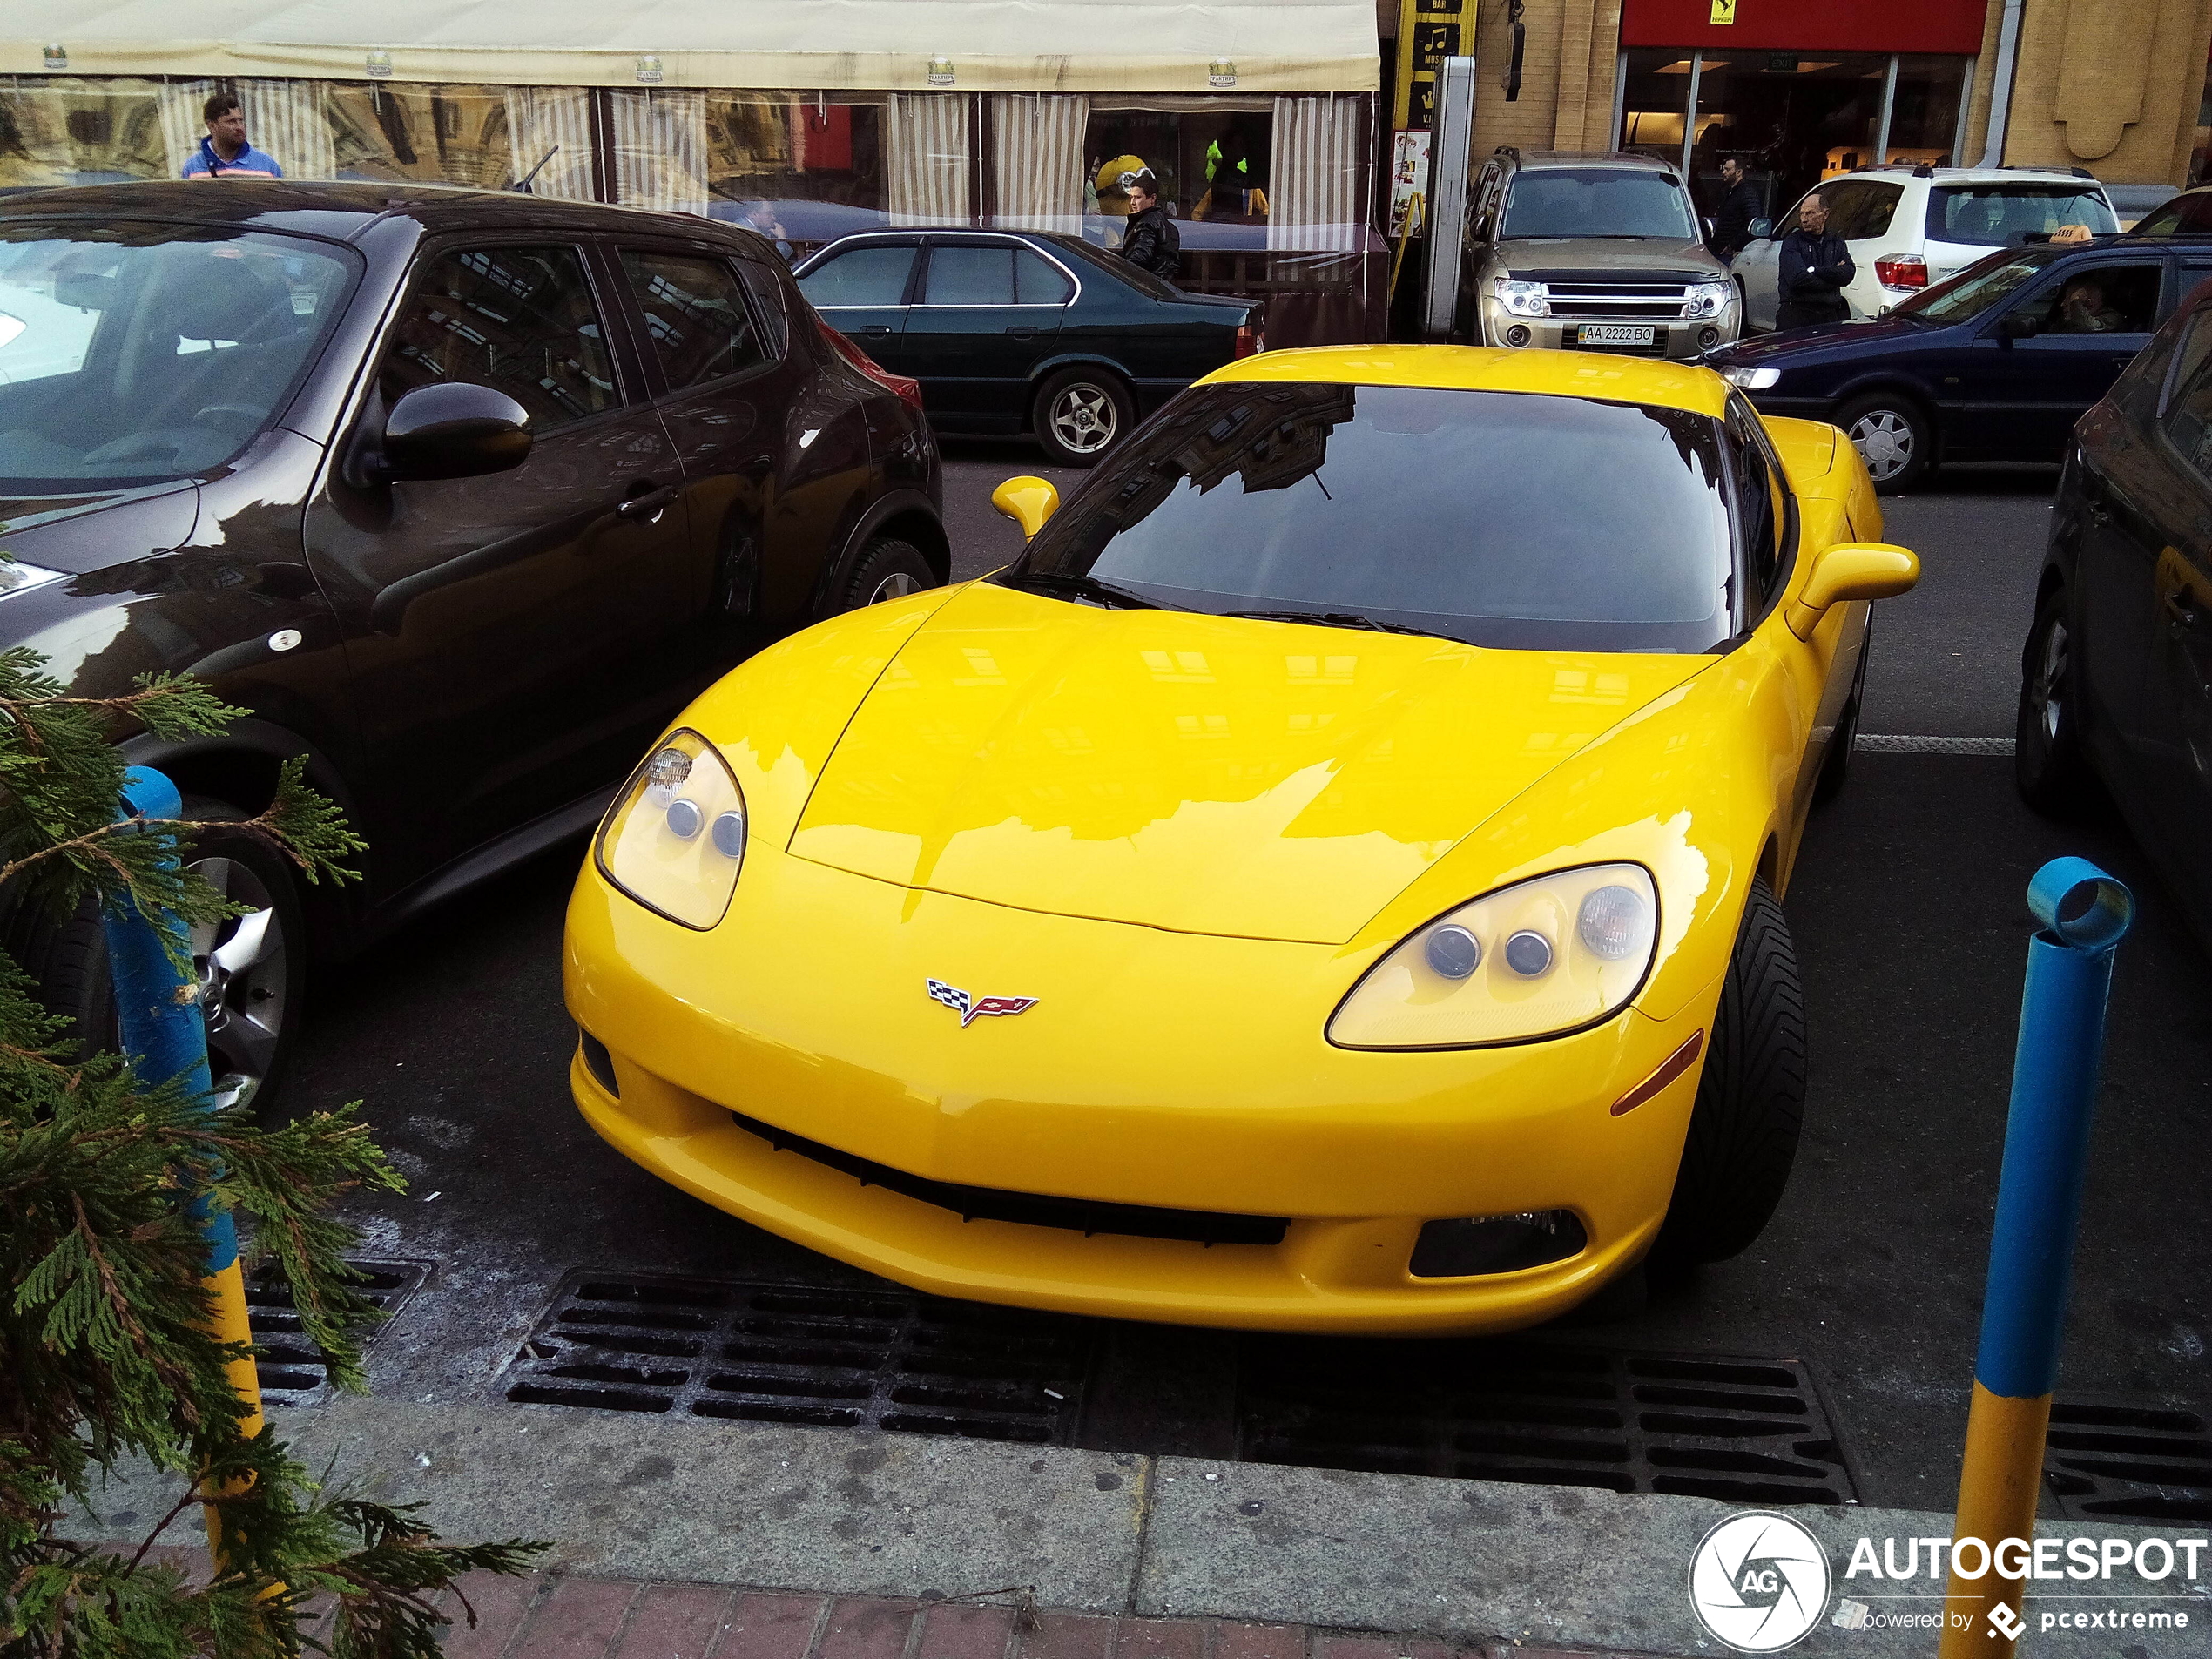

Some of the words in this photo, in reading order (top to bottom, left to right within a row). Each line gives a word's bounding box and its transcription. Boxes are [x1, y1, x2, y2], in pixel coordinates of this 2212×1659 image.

[1433, 0, 1446, 9] BAR
[1586, 327, 1602, 339] AA
[1606, 328, 1632, 339] 2222
[1635, 329, 1651, 340] BO
